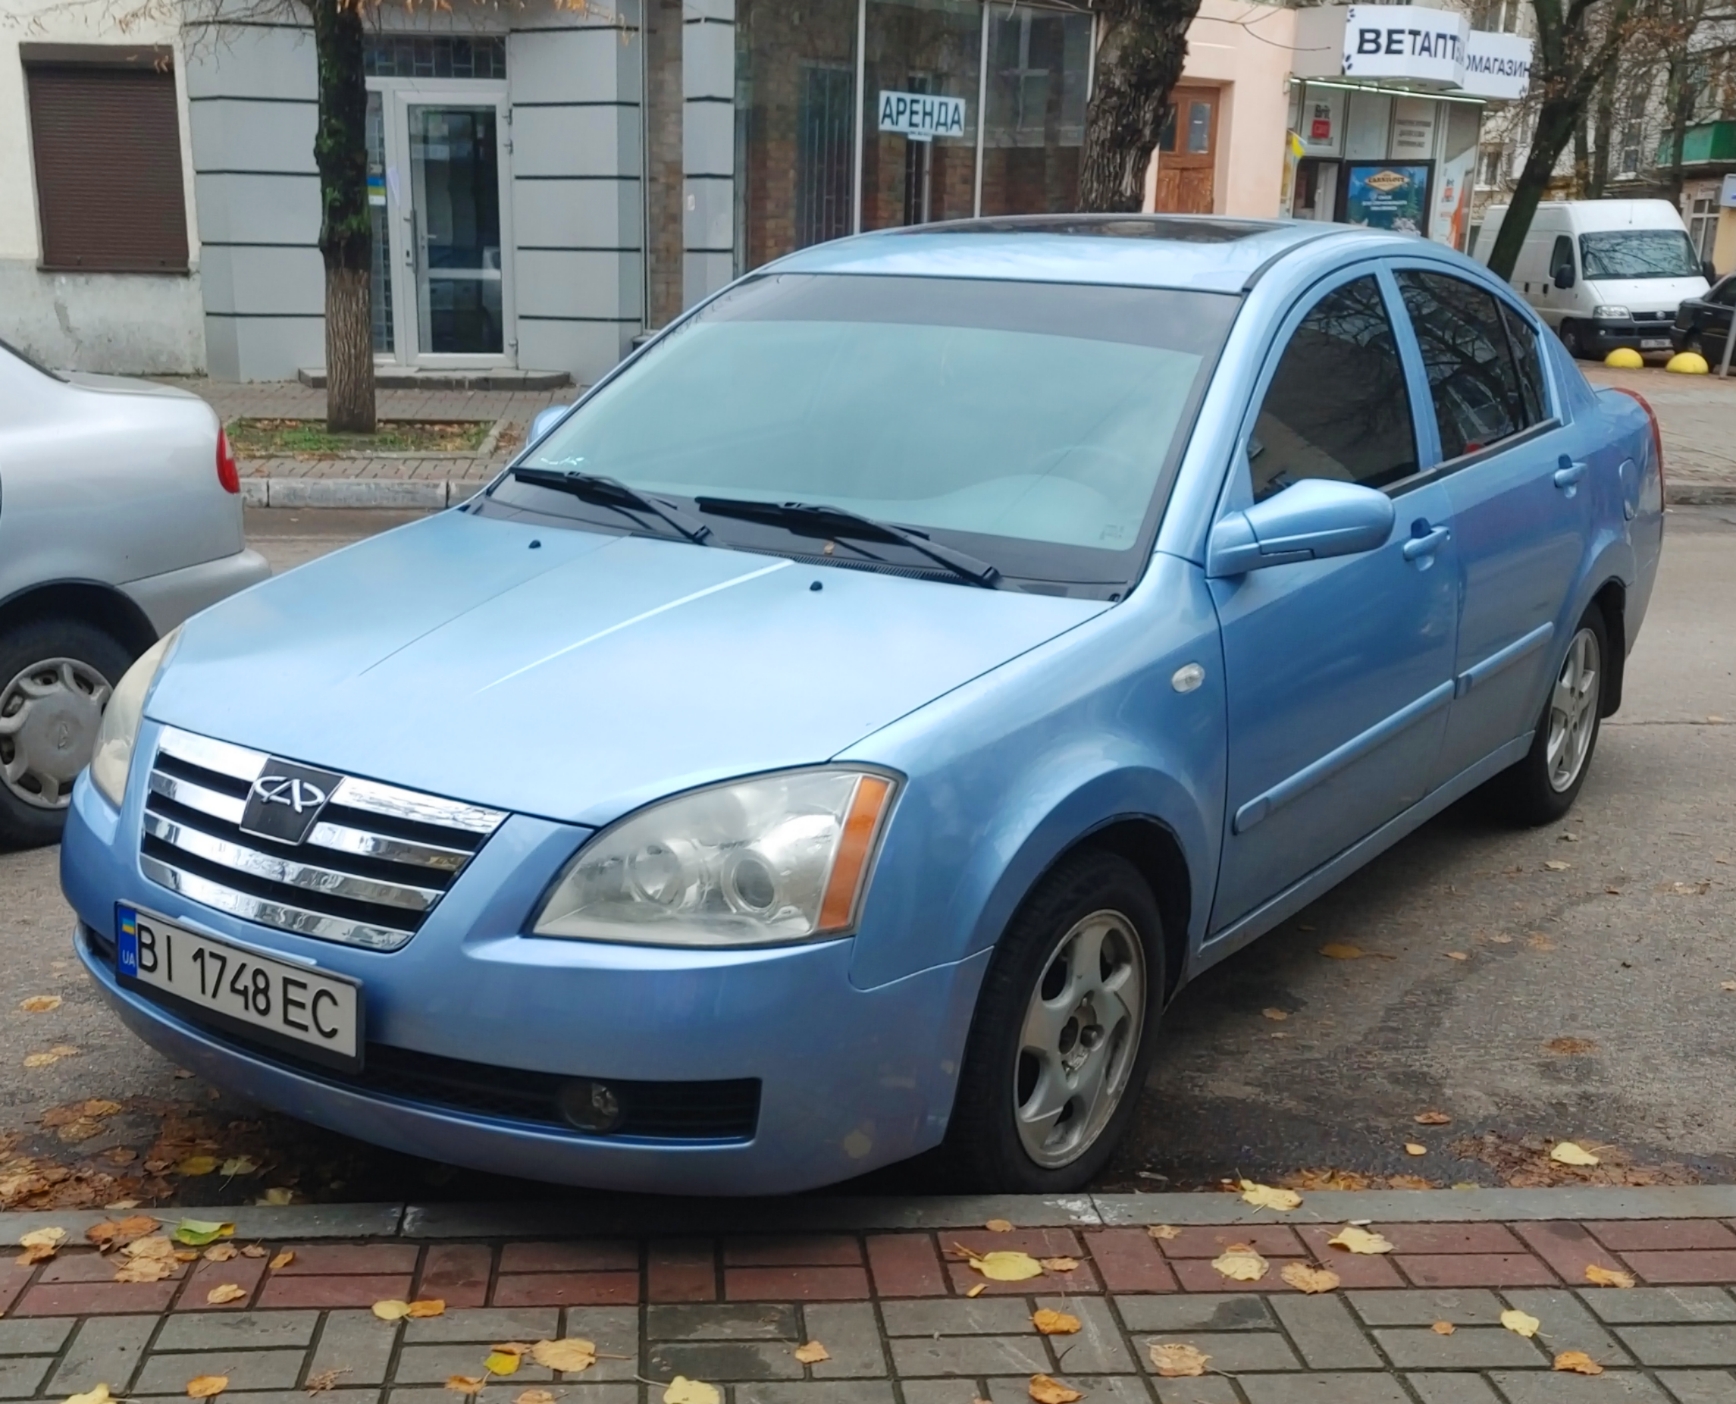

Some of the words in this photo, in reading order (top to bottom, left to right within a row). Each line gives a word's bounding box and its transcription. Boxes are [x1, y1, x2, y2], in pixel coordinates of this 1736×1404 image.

[1357, 28, 1465, 67] ВЕТАПТ
[881, 96, 962, 132] АРЕНДА
[122, 950, 136, 967] UA
[137, 923, 172, 982] BI
[192, 947, 271, 1016] 1748
[282, 976, 338, 1039] EC
